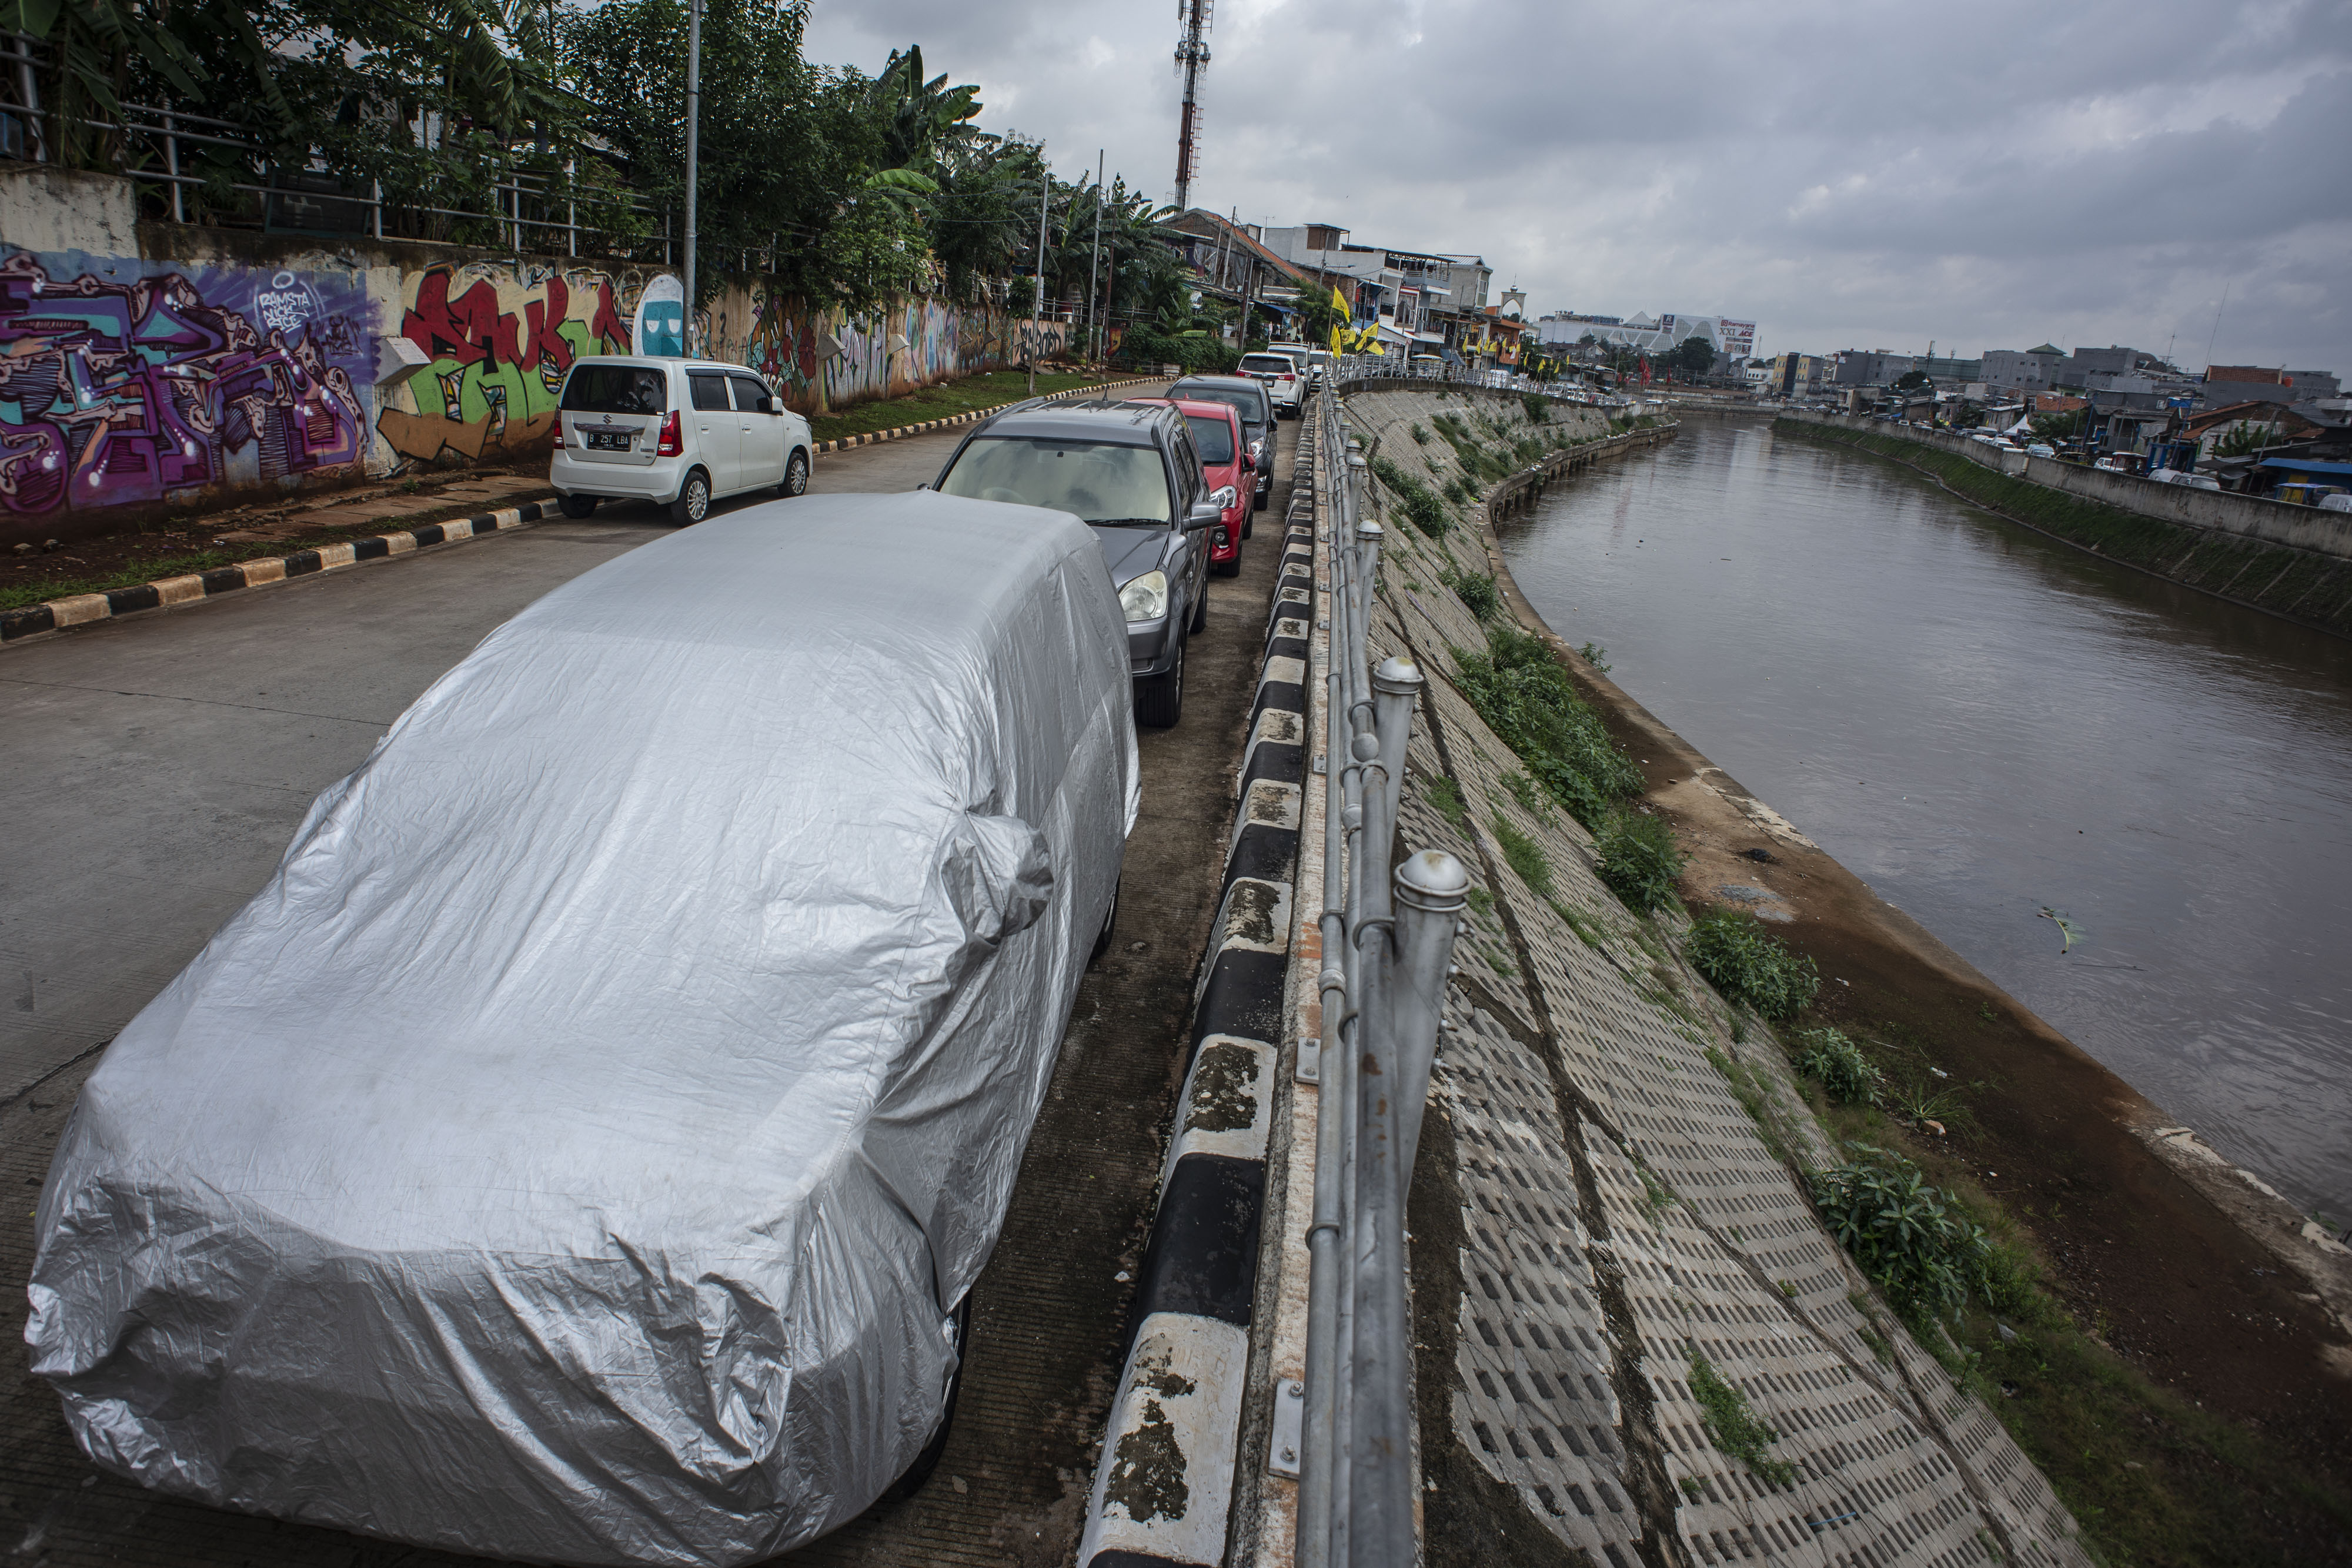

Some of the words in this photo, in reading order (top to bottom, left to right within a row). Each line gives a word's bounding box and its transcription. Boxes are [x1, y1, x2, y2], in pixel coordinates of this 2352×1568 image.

[259, 292, 310, 308] RAMSTA
[266, 315, 302, 330] RICE
[1719, 327, 1735, 336] XXI
[590, 434, 594, 443] B
[600, 435, 612, 443] 257
[617, 436, 629, 444] LBA
